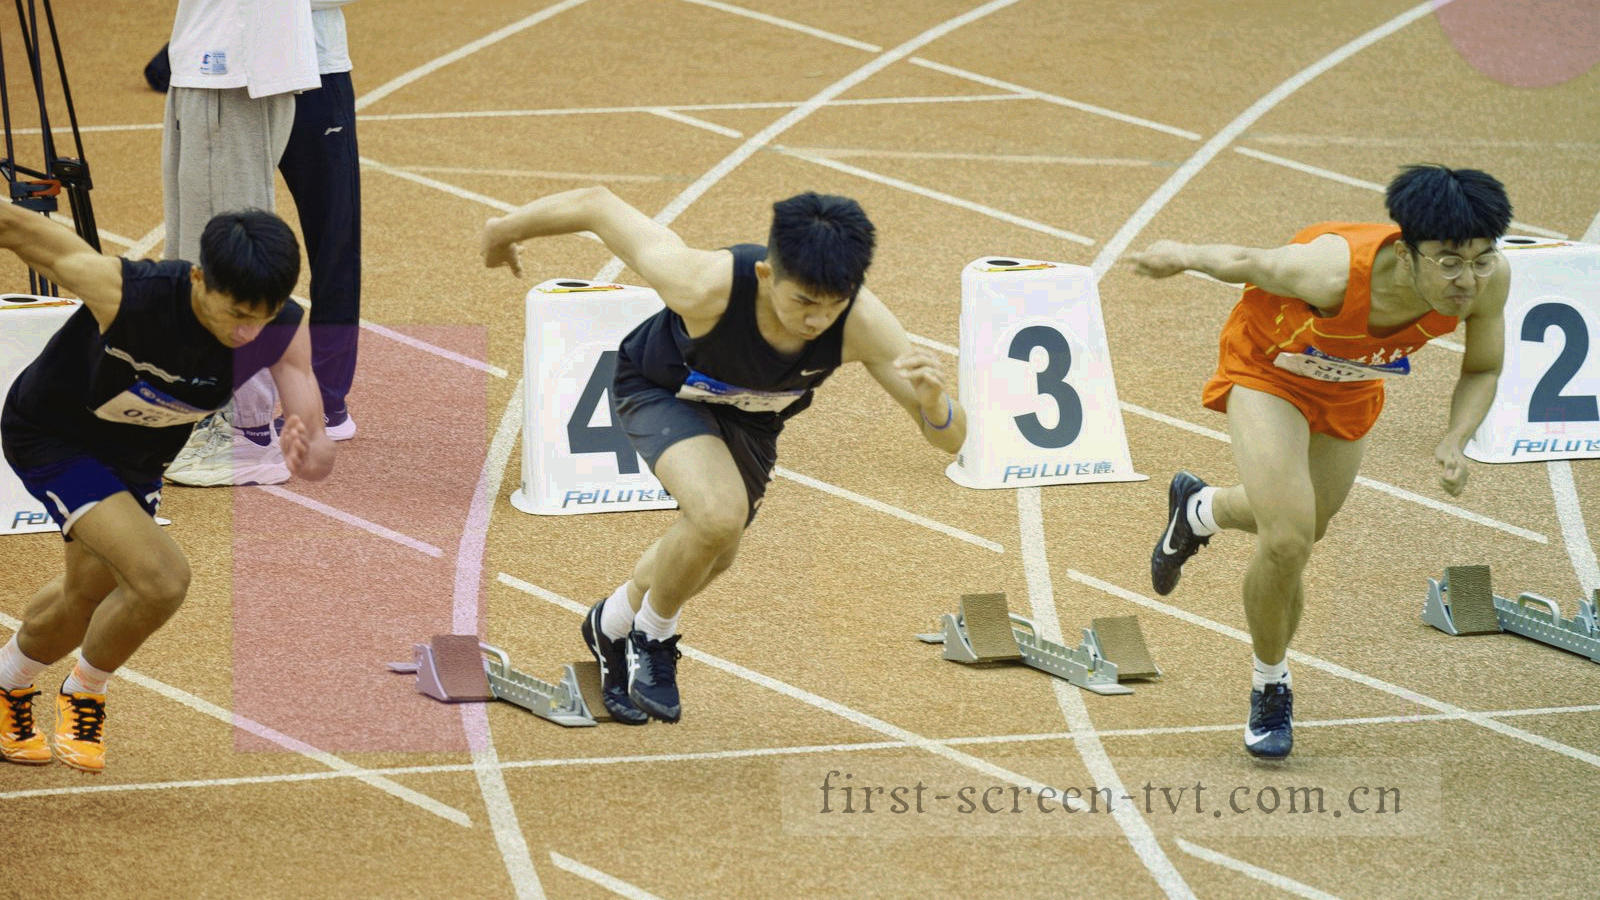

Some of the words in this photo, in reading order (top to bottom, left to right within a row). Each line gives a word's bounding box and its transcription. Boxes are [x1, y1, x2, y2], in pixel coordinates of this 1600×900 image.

[567, 350, 641, 475] 4
[1007, 325, 1083, 449] 3
[1520, 302, 1600, 422] 2
